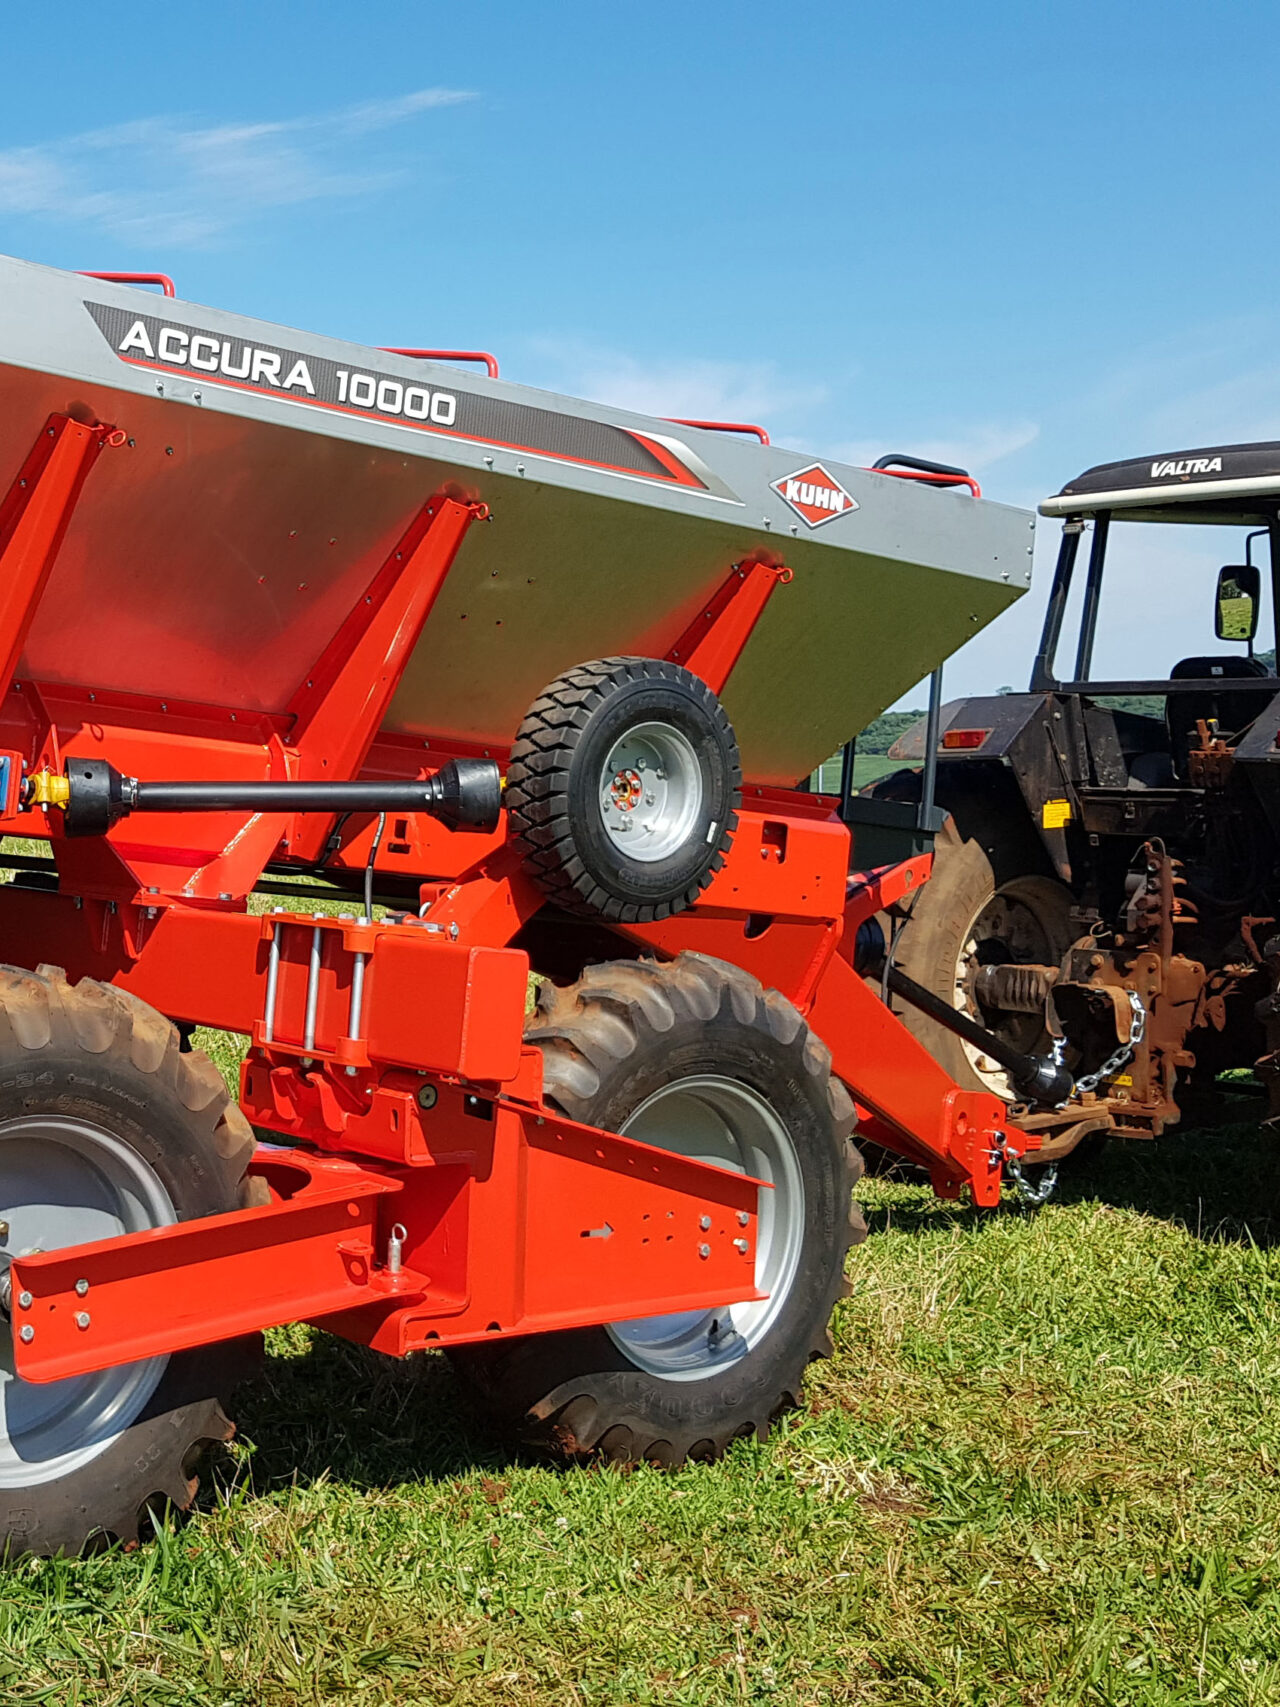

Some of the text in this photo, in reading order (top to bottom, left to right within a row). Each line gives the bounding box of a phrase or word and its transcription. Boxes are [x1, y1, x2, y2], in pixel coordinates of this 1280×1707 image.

[119, 320, 457, 426] ACCURA 10000
[1150, 457, 1222, 478] VALTRA
[786, 479, 845, 513] KUHN
